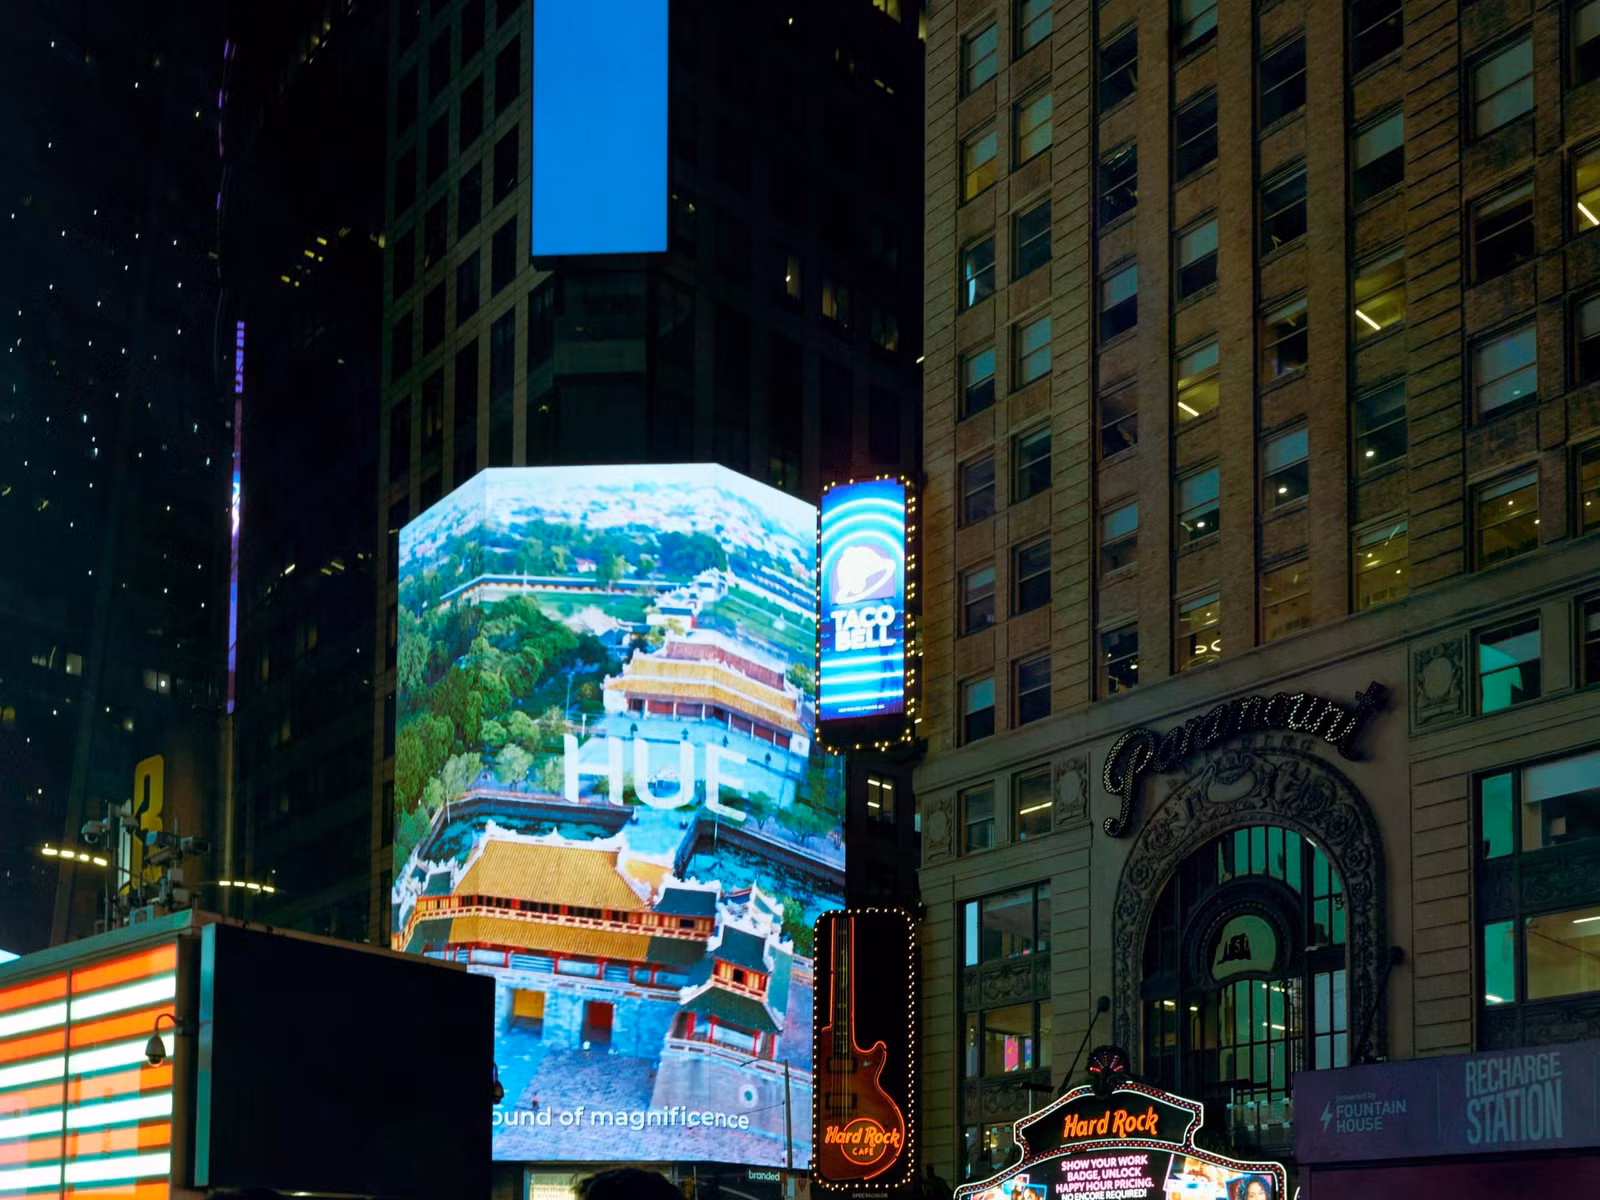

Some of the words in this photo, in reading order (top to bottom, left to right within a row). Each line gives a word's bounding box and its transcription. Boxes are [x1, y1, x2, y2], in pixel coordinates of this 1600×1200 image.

[831, 604, 896, 632] TACO
[835, 625, 896, 652] BELL
[1103, 681, 1386, 838] Paramount
[564, 734, 747, 822] HUE
[1465, 1052, 1562, 1098] RECHARGE
[559, 1106, 585, 1126] of
[590, 1106, 750, 1131] magnificence
[1336, 1099, 1407, 1119] FOUNTAIN
[1466, 1078, 1563, 1144] STATION
[1063, 1110, 1109, 1138] Hard
[1113, 1105, 1159, 1138] Rock
[1336, 1116, 1383, 1133] HOUSE
[825, 1126, 863, 1144] Hard
[864, 1126, 900, 1148] Rock
[852, 1147, 874, 1156] CAFE
[1061, 1160, 1090, 1171] SHOW
[1091, 1157, 1117, 1168] YOUR
[1118, 1154, 1148, 1166] WORK
[749, 1170, 780, 1181] branded
[1056, 1182, 1086, 1193] HAPPY
[1086, 1180, 1113, 1191] HOUR
[1115, 1177, 1155, 1189] PRICING.
[1067, 1170, 1100, 1182] BADGE,
[1102, 1167, 1142, 1178] UNLOCK
[1075, 1191, 1105, 1200] ENCORE
[1106, 1188, 1147, 1200] REQUIRED!
